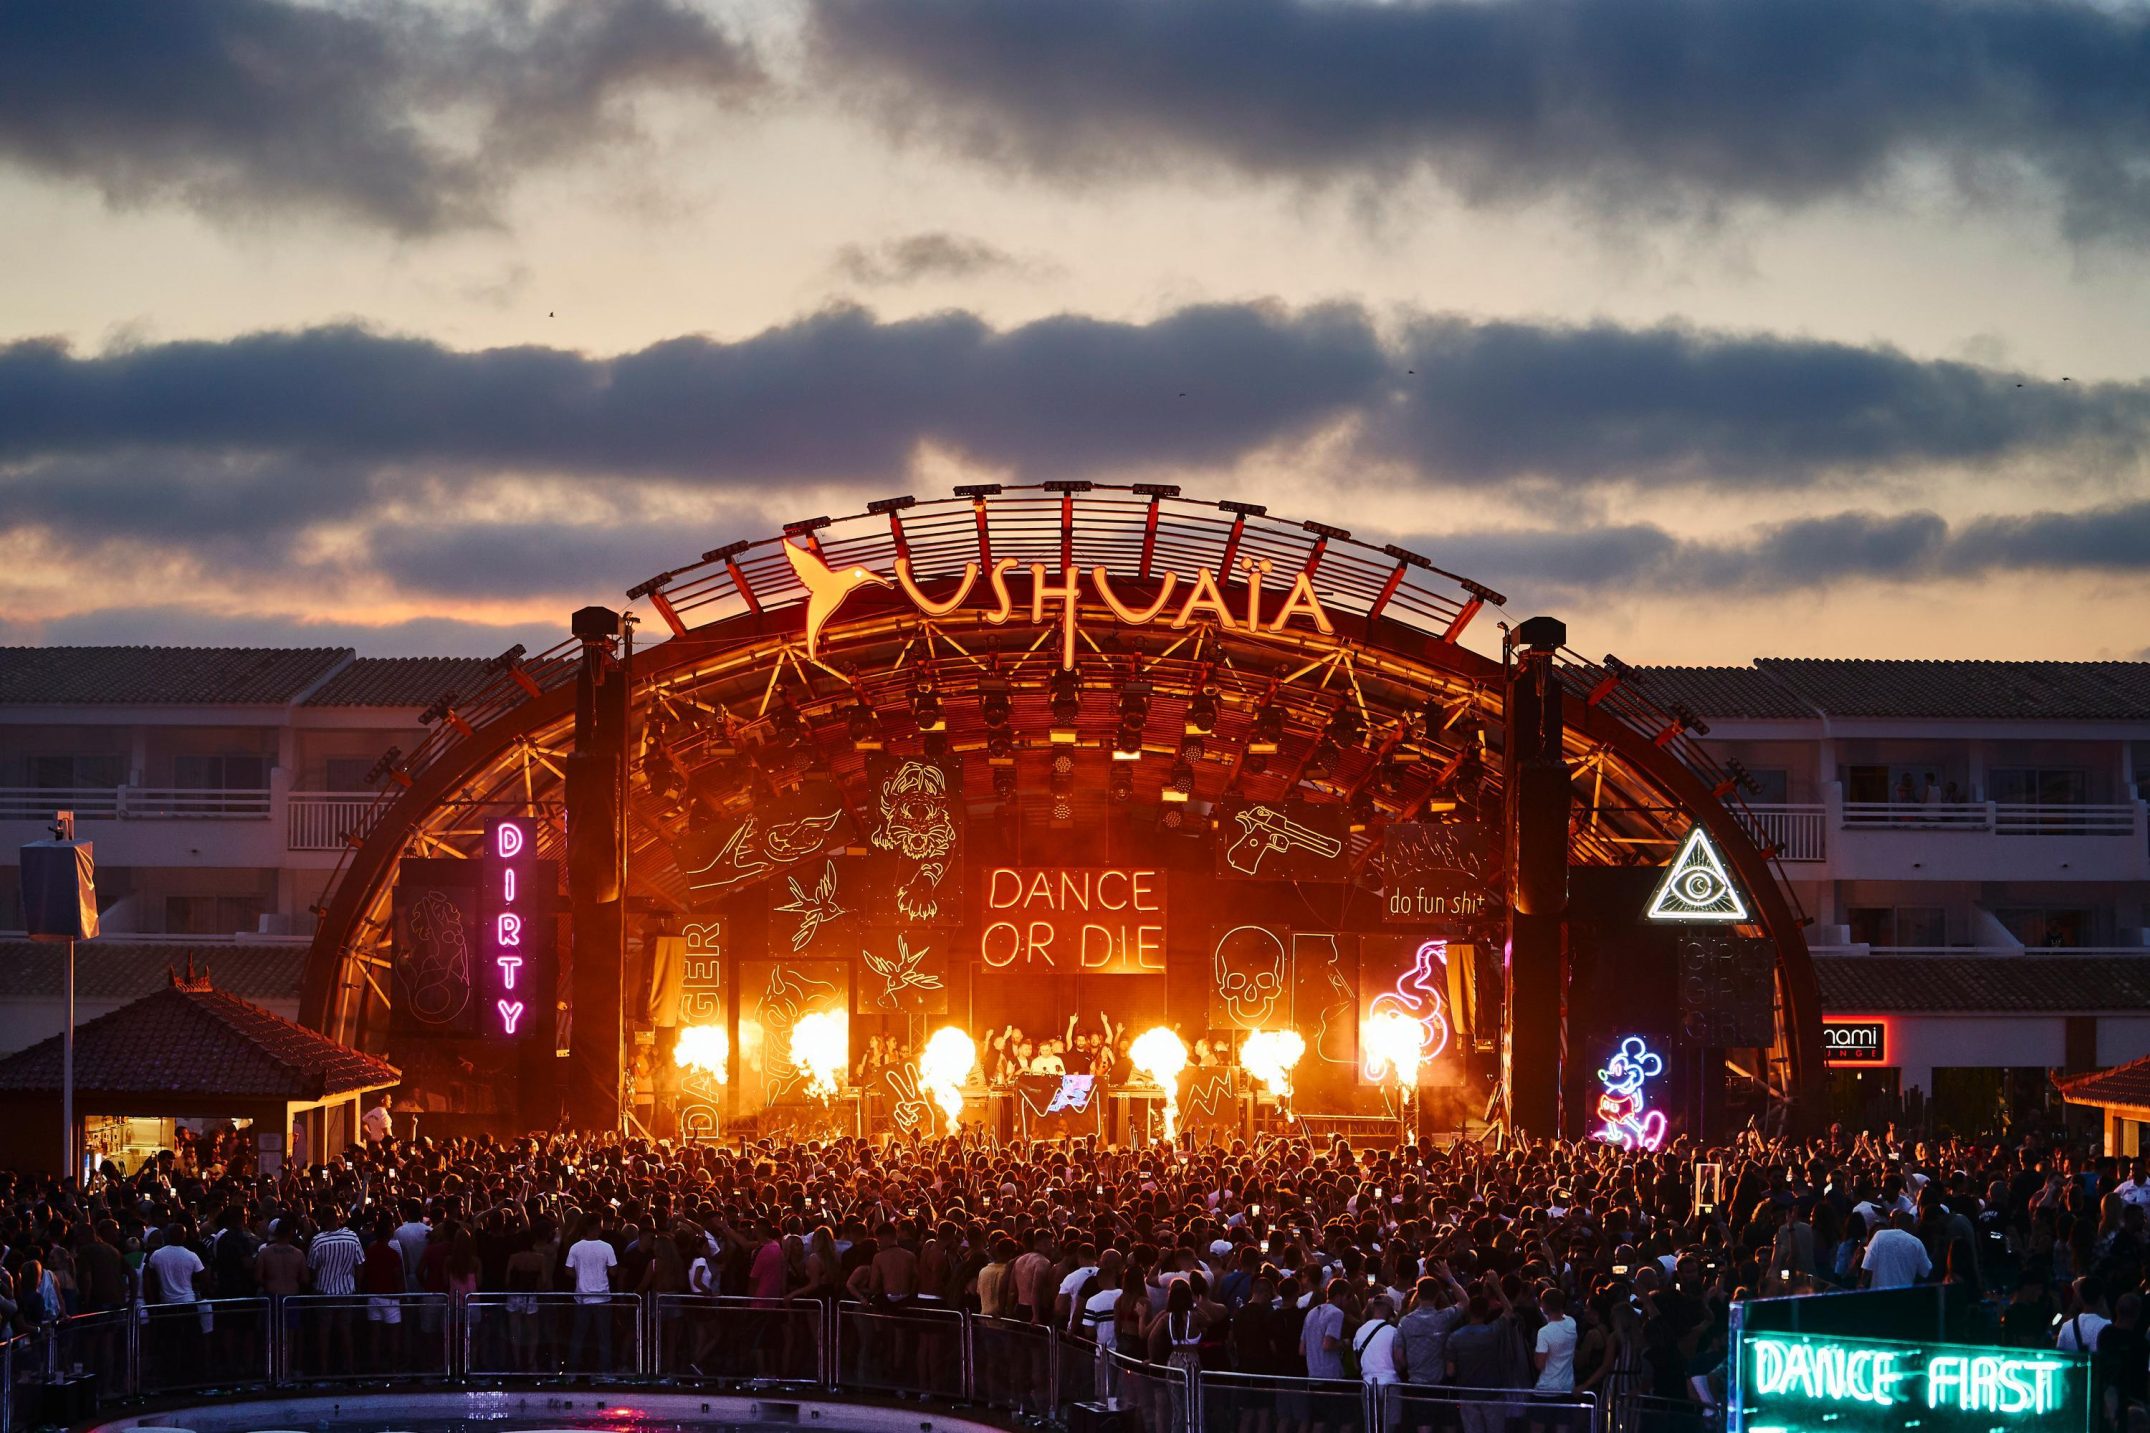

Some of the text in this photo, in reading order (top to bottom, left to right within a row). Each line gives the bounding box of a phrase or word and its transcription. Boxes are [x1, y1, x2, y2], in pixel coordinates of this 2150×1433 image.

[893, 556, 1335, 671] USHUAÏA
[498, 822, 524, 1034] DIRTY
[989, 869, 1160, 912] DANCE
[1390, 887, 1485, 914] do fun shit
[981, 921, 1166, 970] OR DIE
[681, 922, 720, 1139] DAGER
[1754, 1339, 2064, 1415] DANCE FIRST
